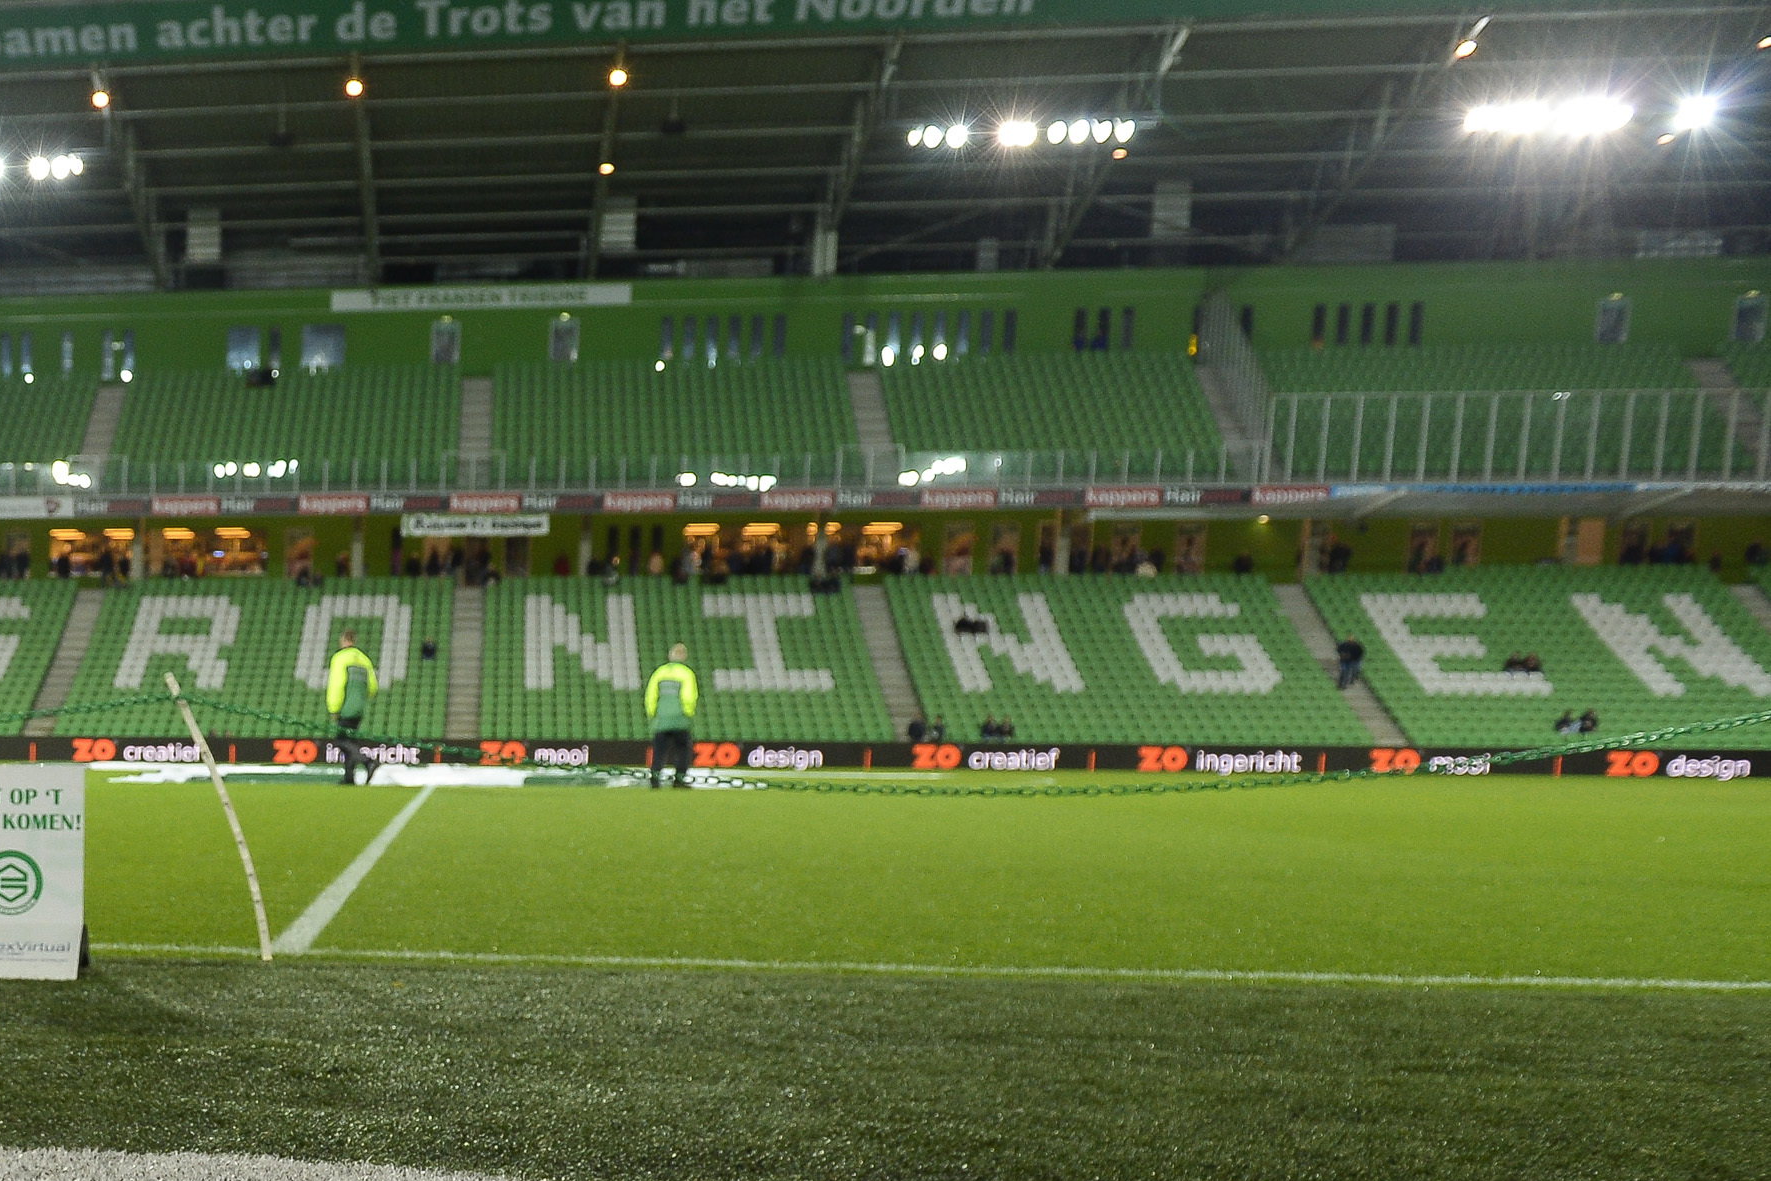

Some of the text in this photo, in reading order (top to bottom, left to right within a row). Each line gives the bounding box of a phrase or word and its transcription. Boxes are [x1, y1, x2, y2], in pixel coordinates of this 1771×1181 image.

[155, 5, 319, 48] achter
[334, 1, 399, 42] de
[415, 0, 552, 38] Trots
[568, 0, 666, 32] van
[72, 738, 117, 762] ZO
[272, 740, 319, 764] ZO
[480, 740, 589, 766] ZO mooi
[692, 742, 823, 770] ZO design
[911, 743, 1061, 770] ZO creatief
[1136, 745, 1302, 776] ZO ingericht
[1369, 748, 1424, 775] ZO
[1605, 750, 1751, 781] ZO design
[10, 788, 38, 805] OP
[3, 813, 82, 831] KOMEN!
